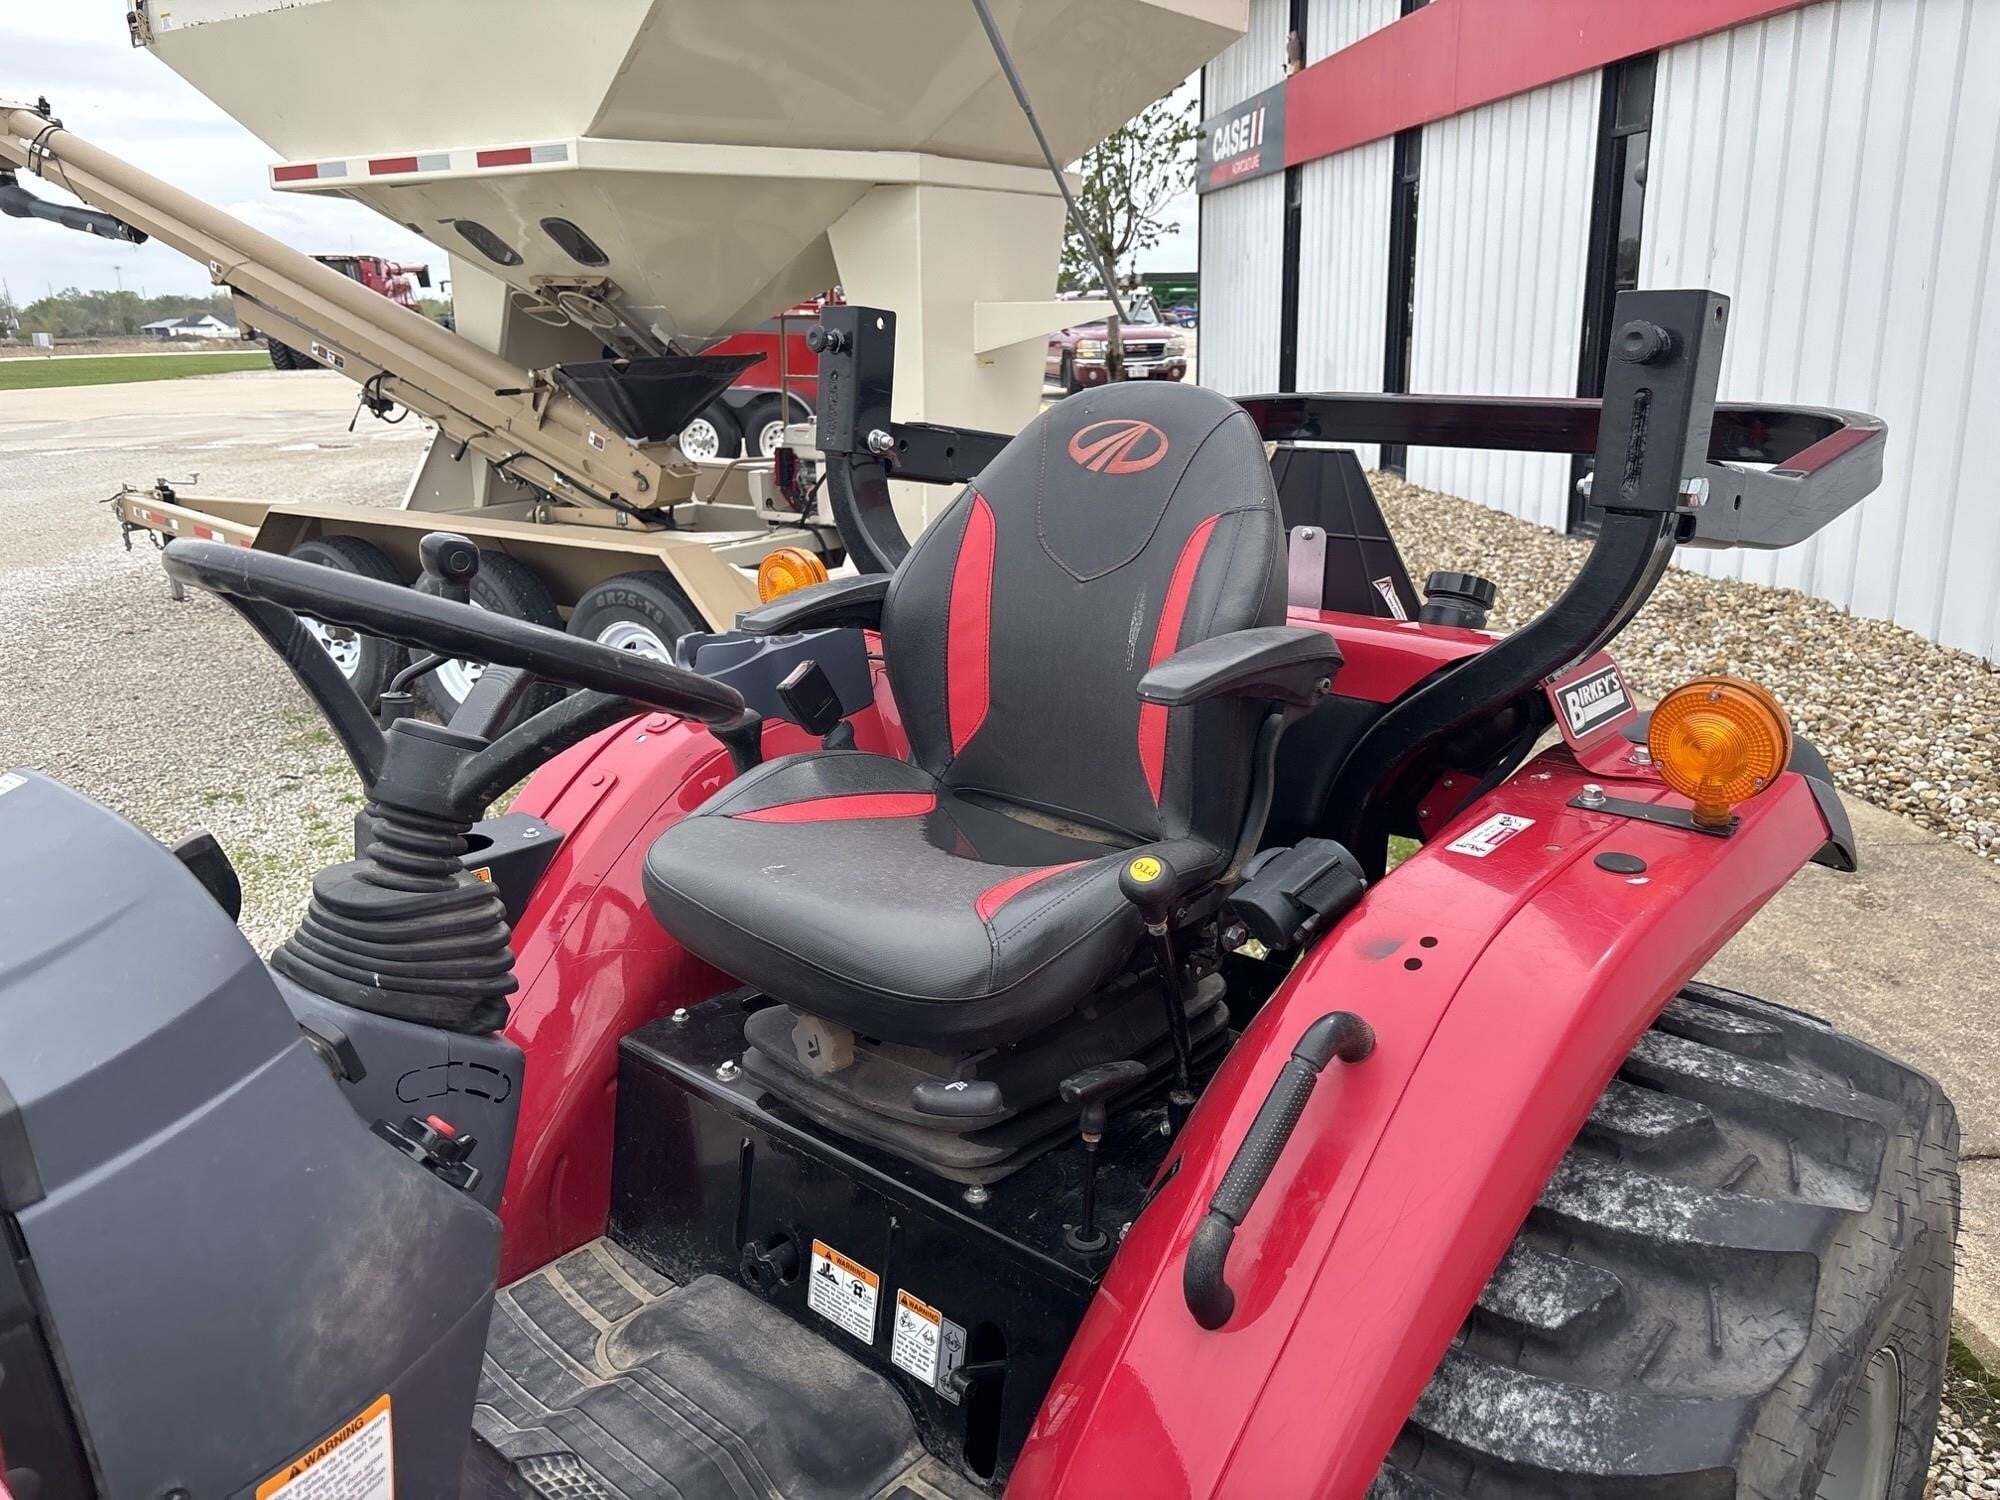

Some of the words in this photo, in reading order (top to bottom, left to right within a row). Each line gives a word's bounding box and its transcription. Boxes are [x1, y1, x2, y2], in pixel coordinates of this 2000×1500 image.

[1565, 671, 1620, 731] BIRKEY'S
[1134, 861, 1158, 877] PTO
[836, 1256, 866, 1280] WARNING
[910, 1302, 939, 1322] WARNING
[304, 1417, 364, 1467] WARNING
